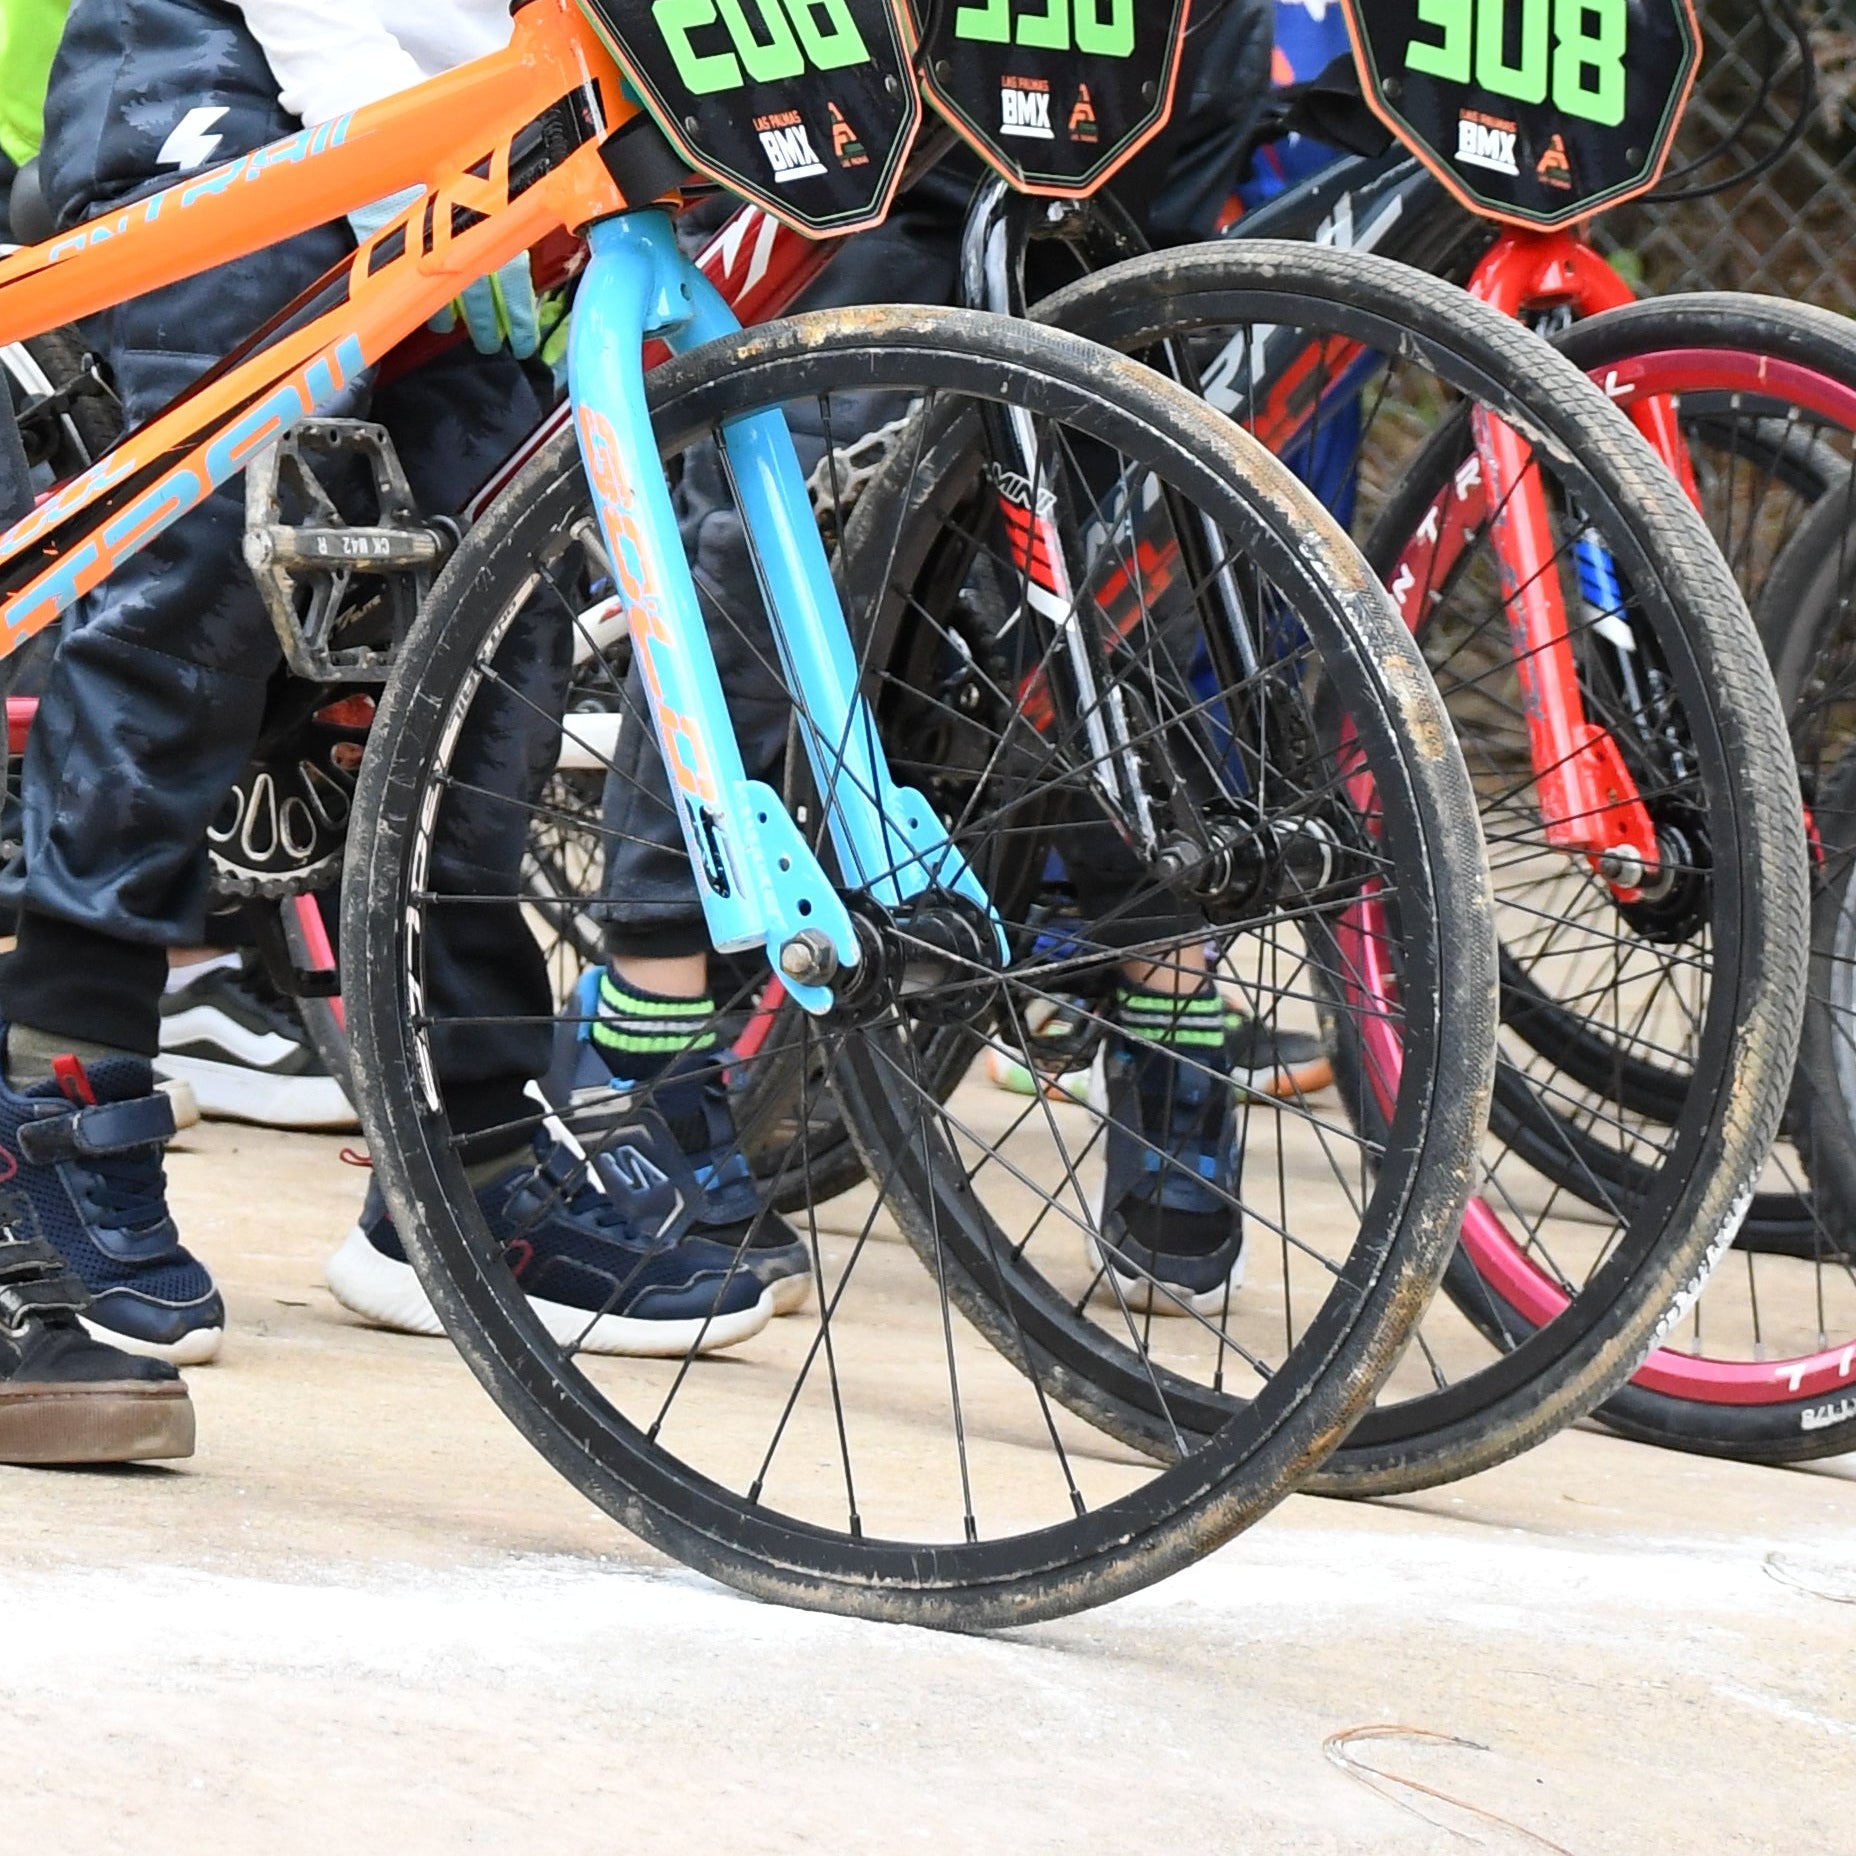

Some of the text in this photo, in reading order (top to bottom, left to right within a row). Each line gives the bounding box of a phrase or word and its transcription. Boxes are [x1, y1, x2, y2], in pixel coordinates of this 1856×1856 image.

[1001, 88, 1052, 129] BMX
[758, 124, 821, 172] BMX
[1457, 118, 1518, 166] BMX
